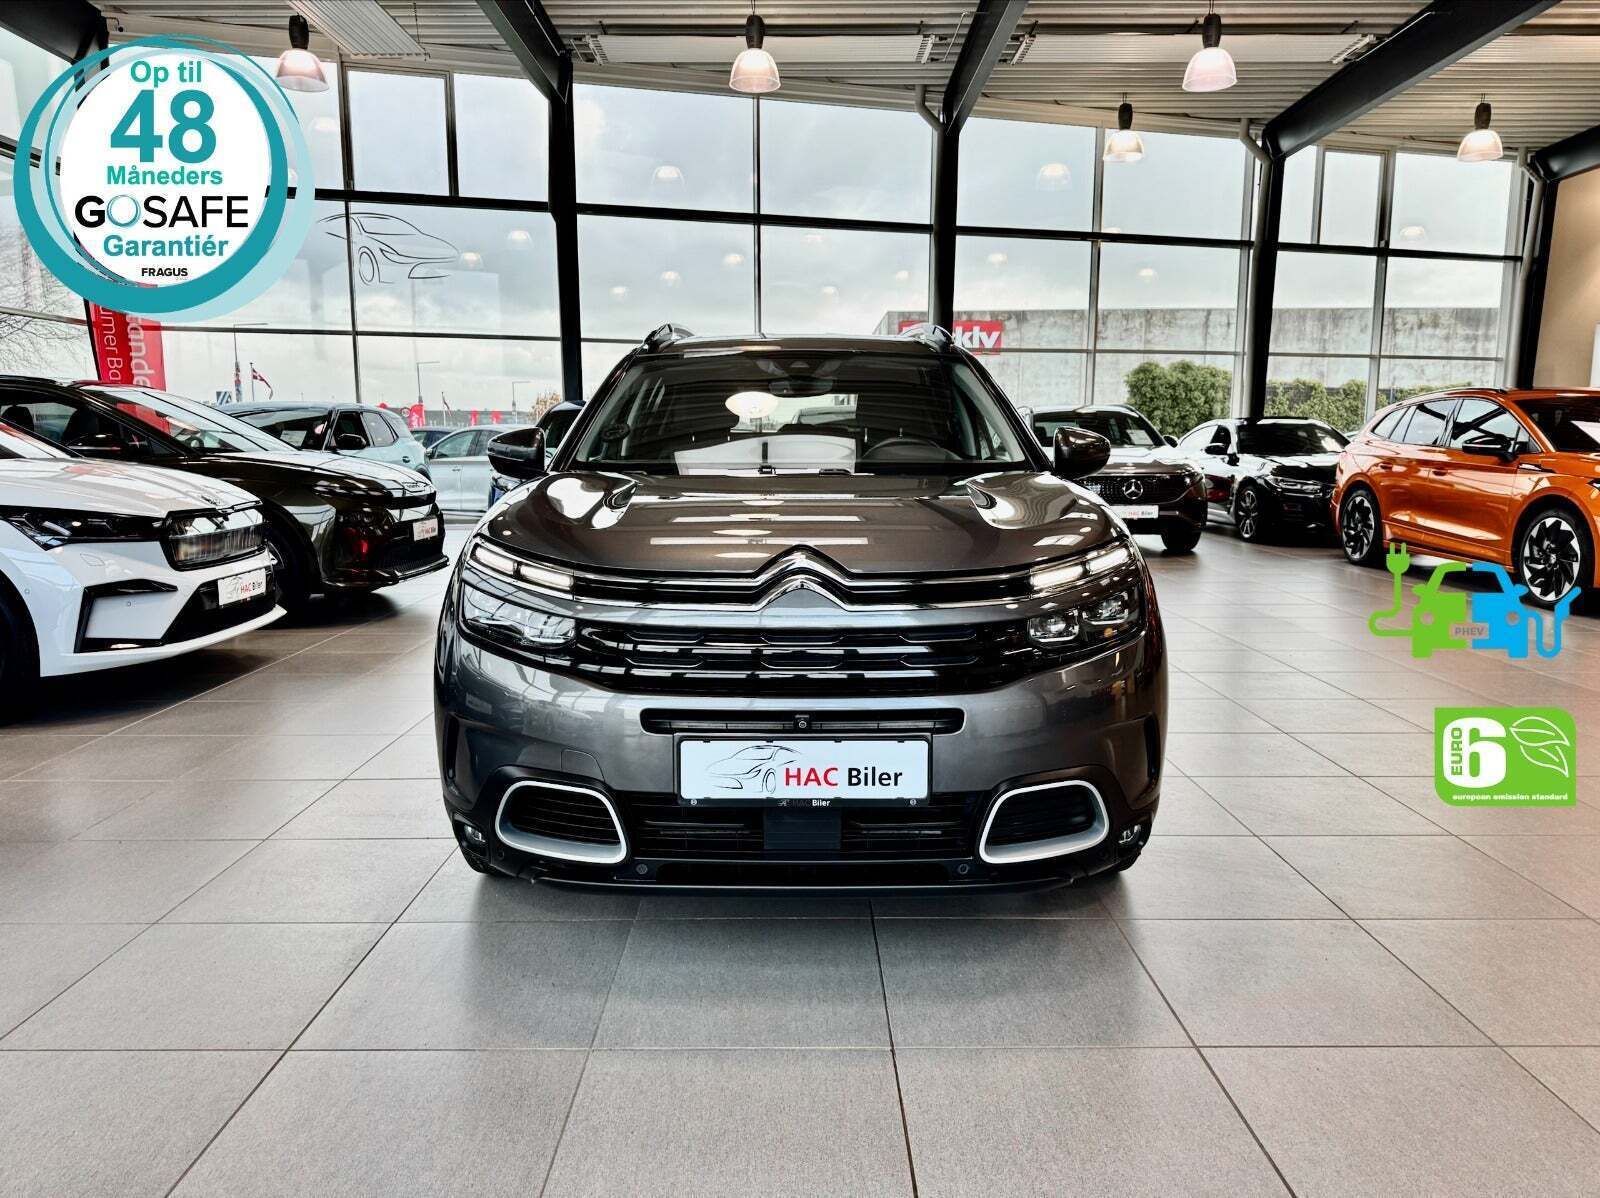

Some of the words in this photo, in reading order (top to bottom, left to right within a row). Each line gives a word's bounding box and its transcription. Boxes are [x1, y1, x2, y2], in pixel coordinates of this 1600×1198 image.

[107, 357, 123, 384] Ba
[785, 767, 839, 787] HAC
[847, 766, 903, 787] Biler
[812, 799, 830, 807] Biler
